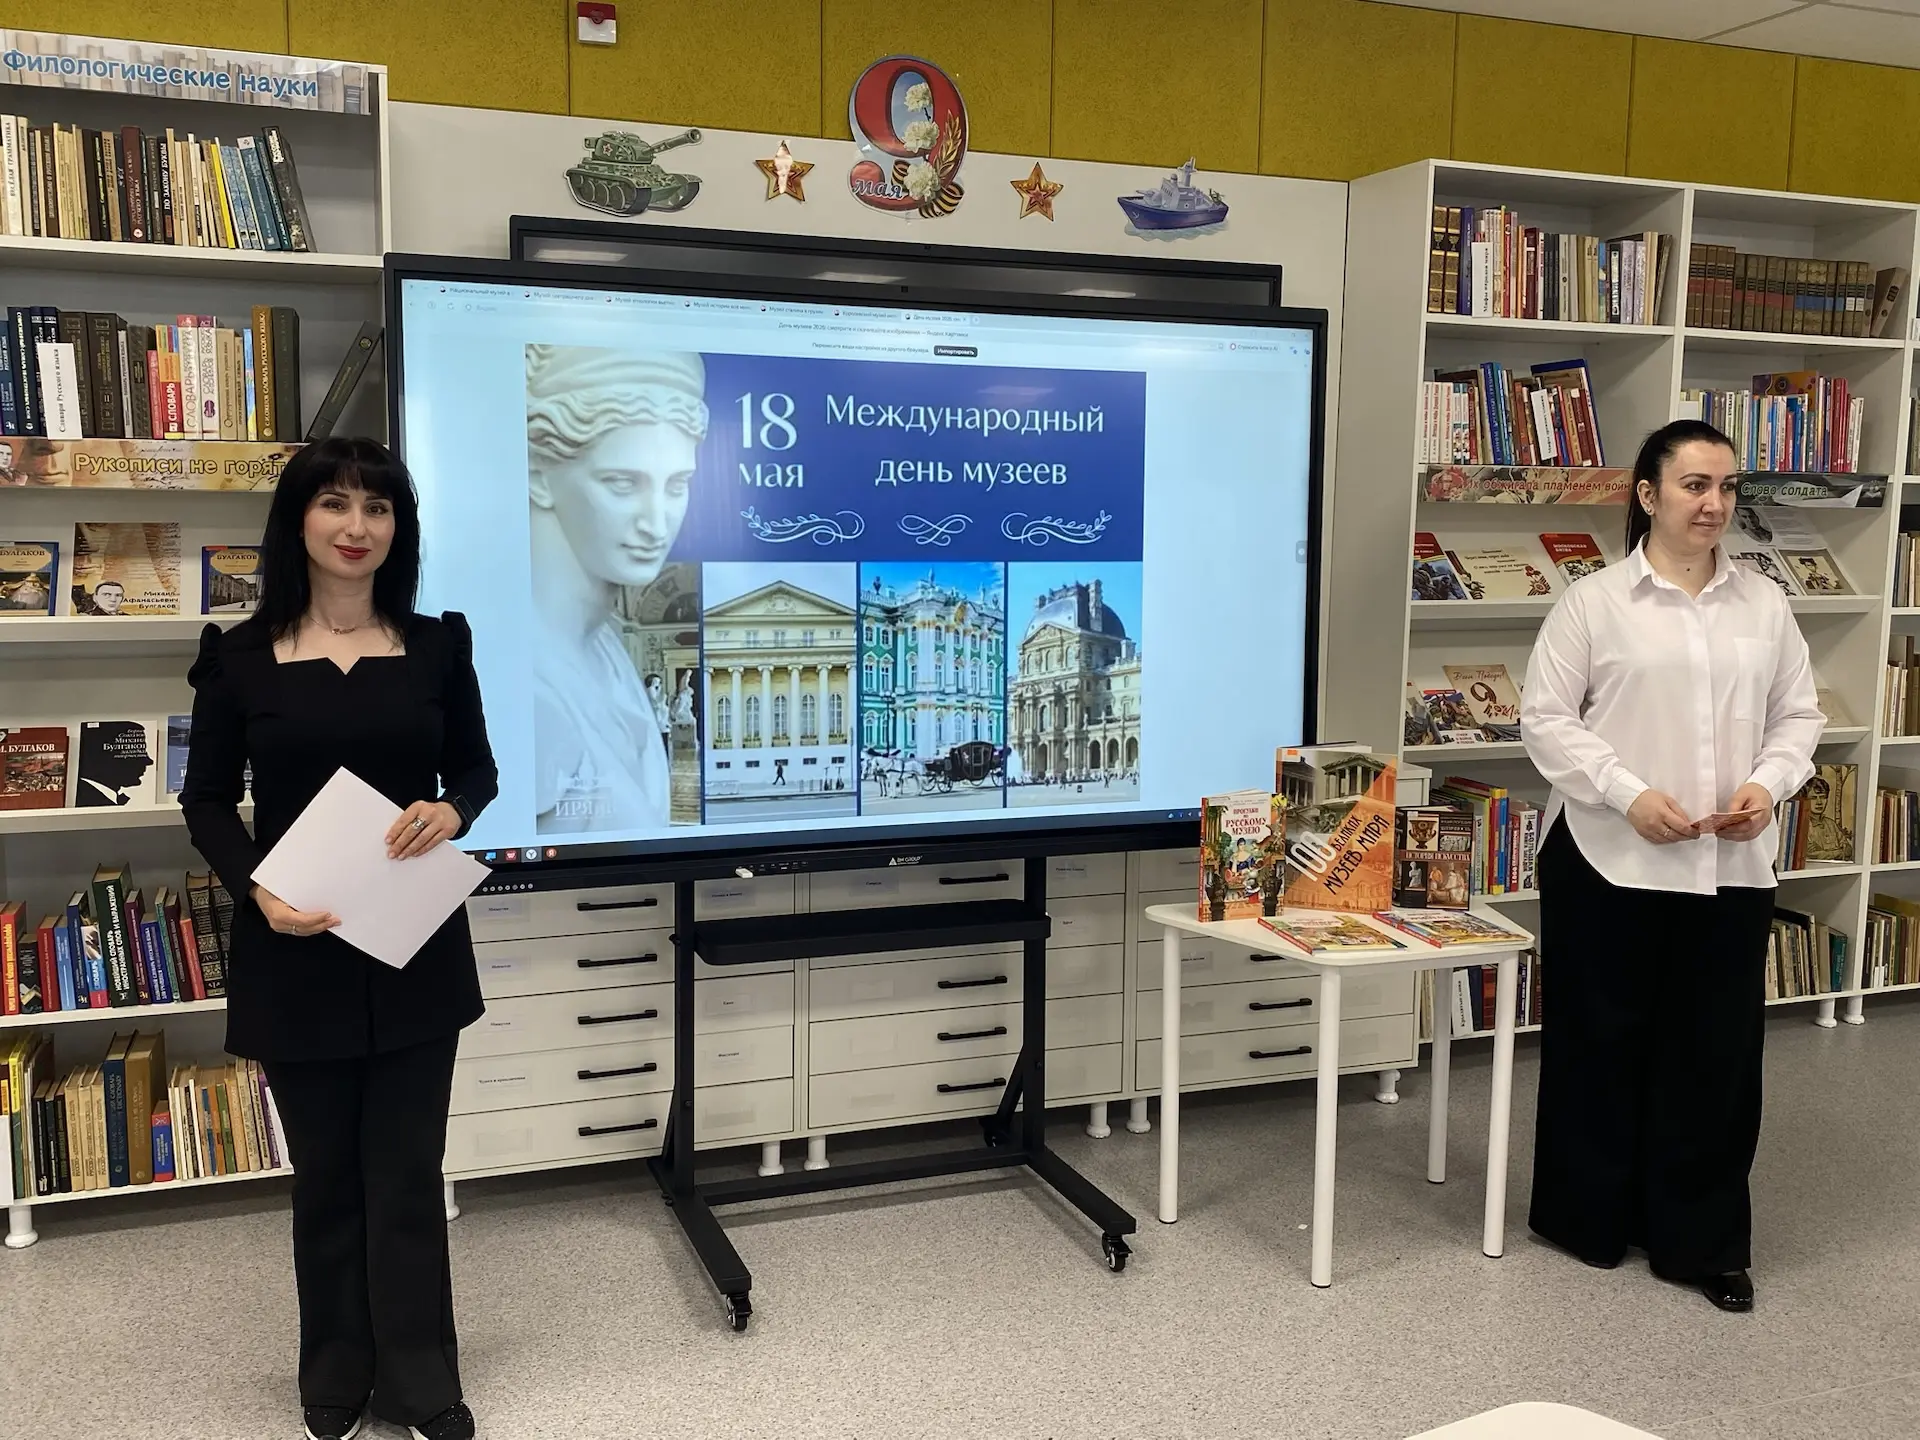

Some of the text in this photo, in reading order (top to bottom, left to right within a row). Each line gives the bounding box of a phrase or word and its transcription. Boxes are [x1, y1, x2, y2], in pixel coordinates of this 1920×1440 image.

[3, 48, 317, 99] Филологические науки
[5, 122, 14, 165] ГРАММАТИКА
[160, 143, 170, 210] ПО ЗАКОНУ БУКВЫ
[205, 328, 213, 354] ЯЗЫКА
[55, 371, 64, 402] Русского
[163, 382, 177, 421] СЛОВАРЬ
[184, 372, 197, 428] СЛОВАРЬ
[58, 403, 66, 432] Словари
[735, 391, 798, 452] 18
[825, 393, 1105, 437] Международный
[74, 453, 286, 479] Рукописи не горят
[738, 462, 804, 489] мая
[875, 459, 1068, 492] день музеев
[1483, 478, 1539, 492] обжигала
[1543, 481, 1601, 492] пламенем
[1604, 480, 1632, 492] войн
[1741, 481, 1828, 498] Слово солдата
[8, 743, 55, 752] БУЛГАКОВ
[1225, 817, 1267, 828] РУССКОМУ
[1232, 826, 1261, 836] МУЗЕЮ
[1285, 831, 1337, 882] 100
[1323, 814, 1390, 895] МУЗЕЕВ МИРА
[1405, 851, 1471, 861] ИСТОРИЯ ИСКУССТВА
[106, 885, 119, 923] ВЫРАЖЕНИЙ
[92, 961, 100, 990] СЛОВАРЬ
[107, 930, 121, 990] НОВЕЙШИЙ СЛОВАРЬ
[117, 946, 130, 990] ИНОСТРАННЫХ
[115, 1074, 123, 1109] DICTIONARY
